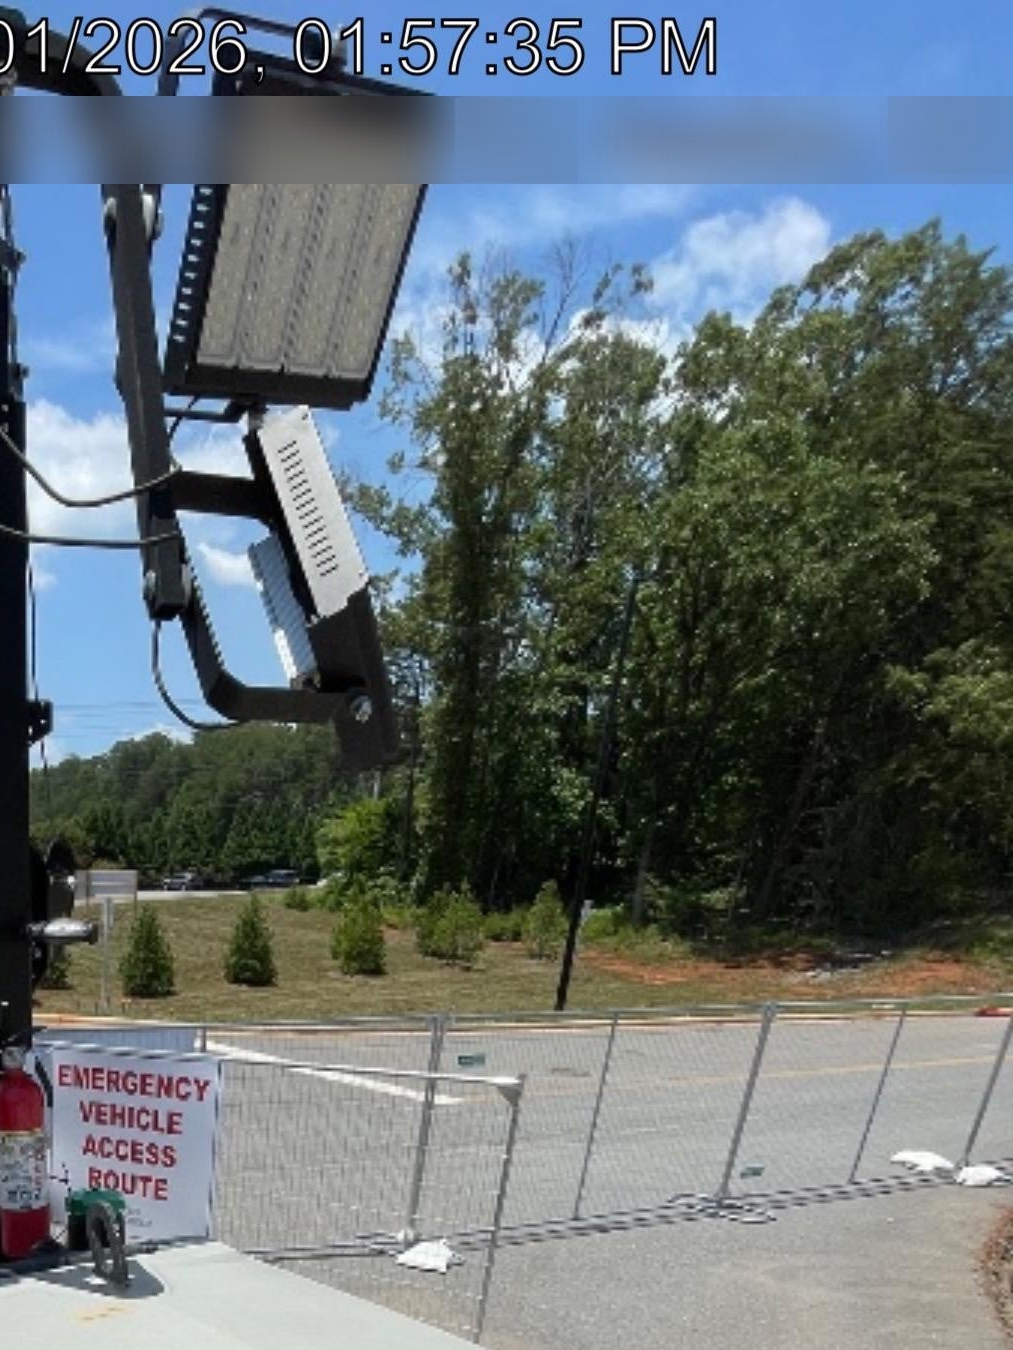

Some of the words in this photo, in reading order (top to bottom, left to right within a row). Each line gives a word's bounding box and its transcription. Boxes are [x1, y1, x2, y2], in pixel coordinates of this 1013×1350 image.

[58, 1064, 211, 1102] EMERGENCY
[79, 1101, 183, 1135] VEHICLE
[82, 1134, 178, 1168] ACCESS
[88, 1166, 169, 1201] ROUTE
